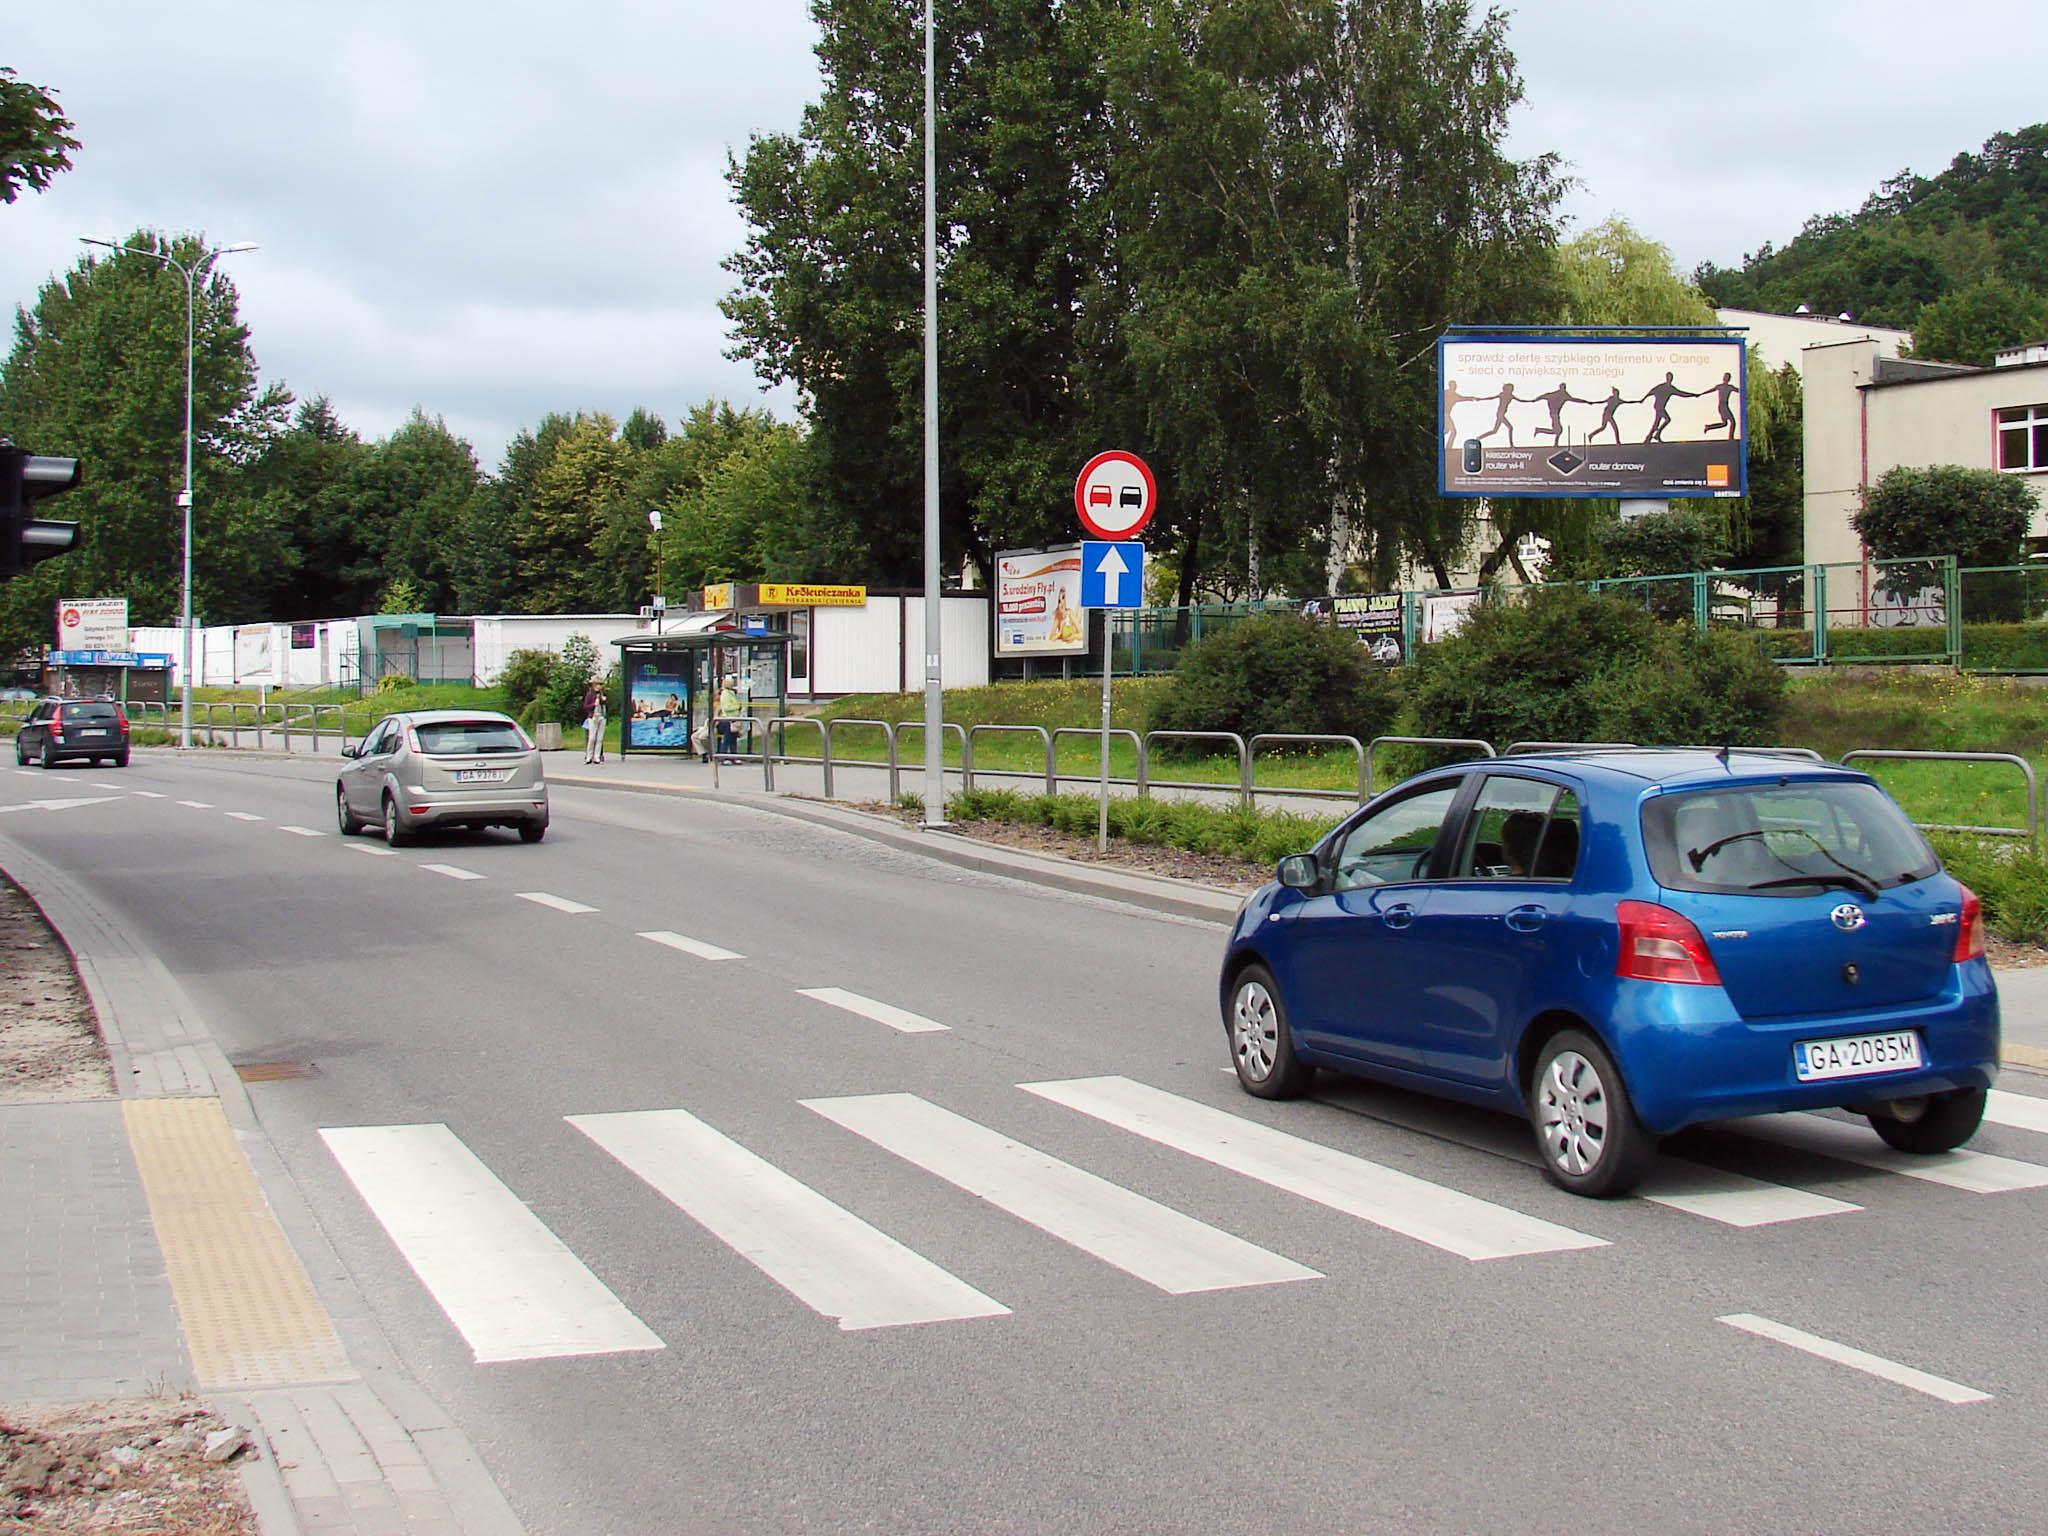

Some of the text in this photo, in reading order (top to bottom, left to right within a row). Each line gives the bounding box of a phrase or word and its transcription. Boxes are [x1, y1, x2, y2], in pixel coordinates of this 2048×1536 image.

[1458, 352, 1504, 364] sprawdź
[1544, 352, 1600, 364] szybkiego
[1604, 353, 1652, 363] Internetu
[1656, 355, 1665, 363] w
[1669, 353, 1710, 365] Orange
[1468, 366, 1494, 375] sieci
[1582, 367, 1625, 377] zasięgu
[1485, 462, 1508, 470] router
[1589, 462, 1645, 472] router domowy
[1810, 1036, 1915, 1070] GA 2085M
